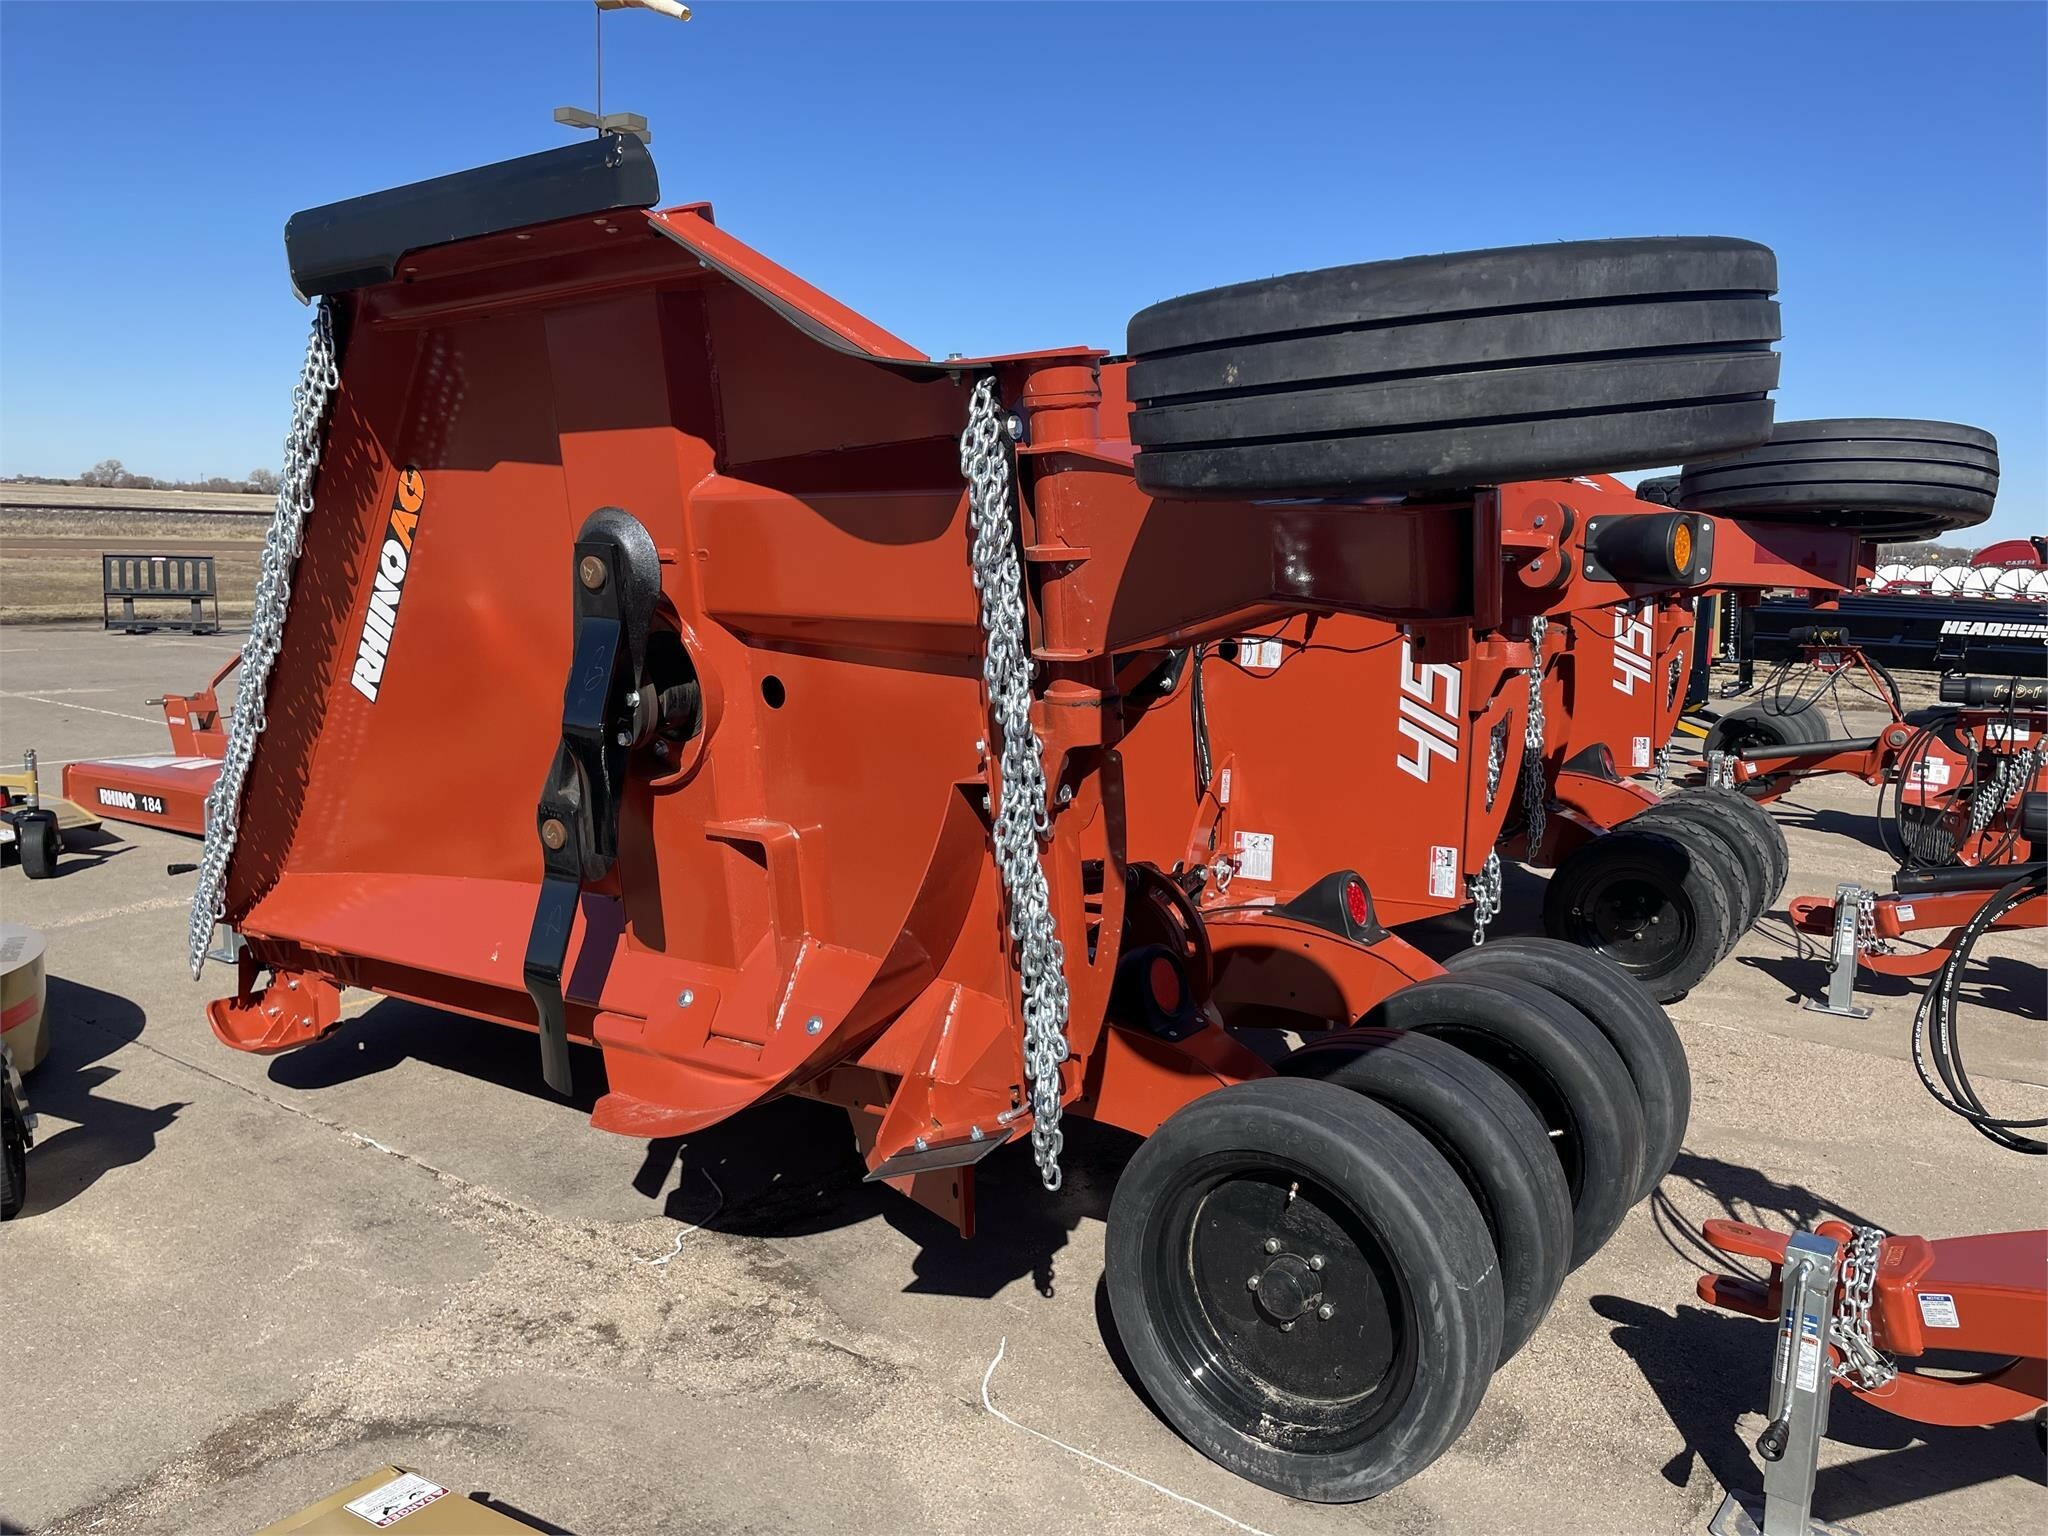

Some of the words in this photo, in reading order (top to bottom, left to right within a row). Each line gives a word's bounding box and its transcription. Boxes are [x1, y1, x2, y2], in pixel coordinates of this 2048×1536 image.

[100, 788, 136, 809] RHINO
[142, 796, 162, 813] 184
[1990, 910, 2004, 922] KURT
[382, 1495, 435, 1526] DANGER
